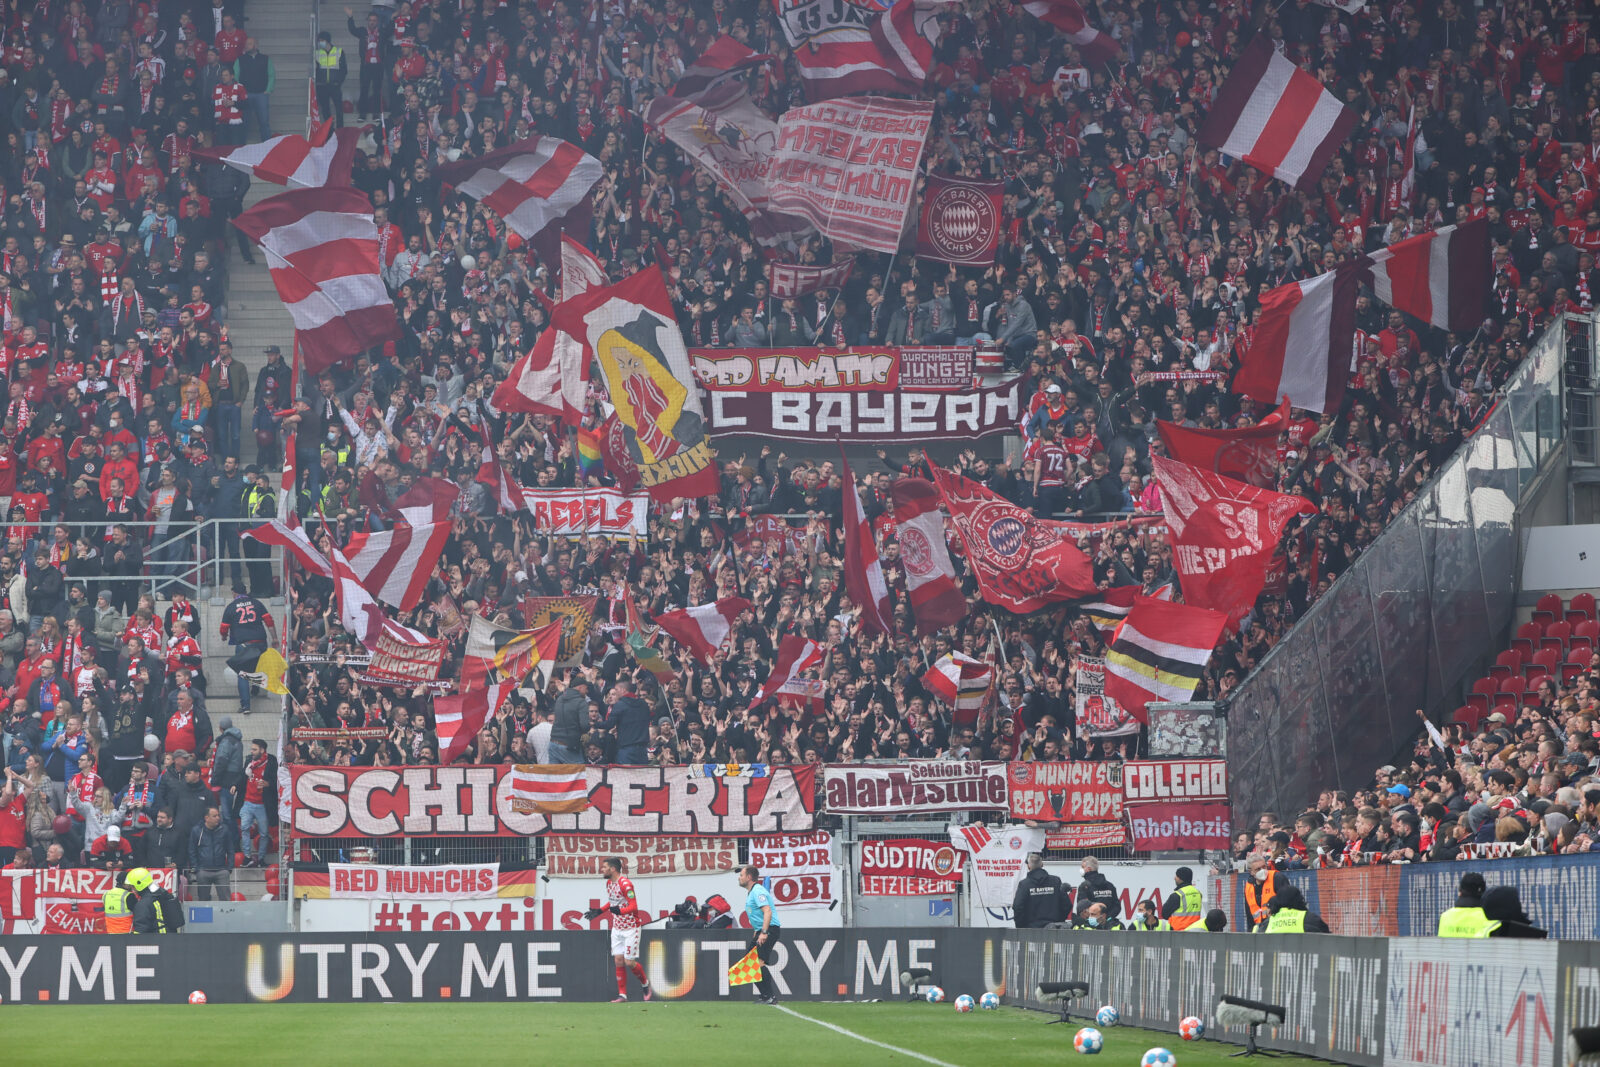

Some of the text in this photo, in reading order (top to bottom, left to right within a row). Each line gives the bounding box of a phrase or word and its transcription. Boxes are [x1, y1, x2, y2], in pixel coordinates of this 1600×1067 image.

[950, 190, 989, 216] BAYERN
[933, 222, 973, 252] MÜNCHEN
[693, 353, 895, 387] RED FANATIC
[901, 353, 972, 362] DURCHHALTEN
[902, 362, 972, 378] JUNGS!
[771, 382, 1019, 433] BAYERN
[1047, 453, 1063, 471] 72
[535, 497, 634, 531] REBELS
[235, 605, 257, 624] 25
[376, 634, 441, 663] SCHICKERIA
[370, 651, 438, 680] MÜNCHEN
[910, 763, 962, 779] Sektion
[1034, 762, 1108, 786] MUNICH'S
[1124, 762, 1227, 799] COLEGIO
[1012, 789, 1123, 819] RED PRIDE
[1132, 815, 1231, 839] Rhoibazis
[751, 831, 831, 850] WIR SIND
[1048, 838, 1077, 847] IMMER
[547, 850, 733, 875] IMMR BEI UNS
[751, 848, 831, 869] BEI DIR
[335, 868, 380, 894] RED
[760, 875, 832, 903] OBI
[862, 875, 917, 894] LETZTE
[626, 945, 632, 955] 3
[0, 944, 161, 1001] Y.ME
